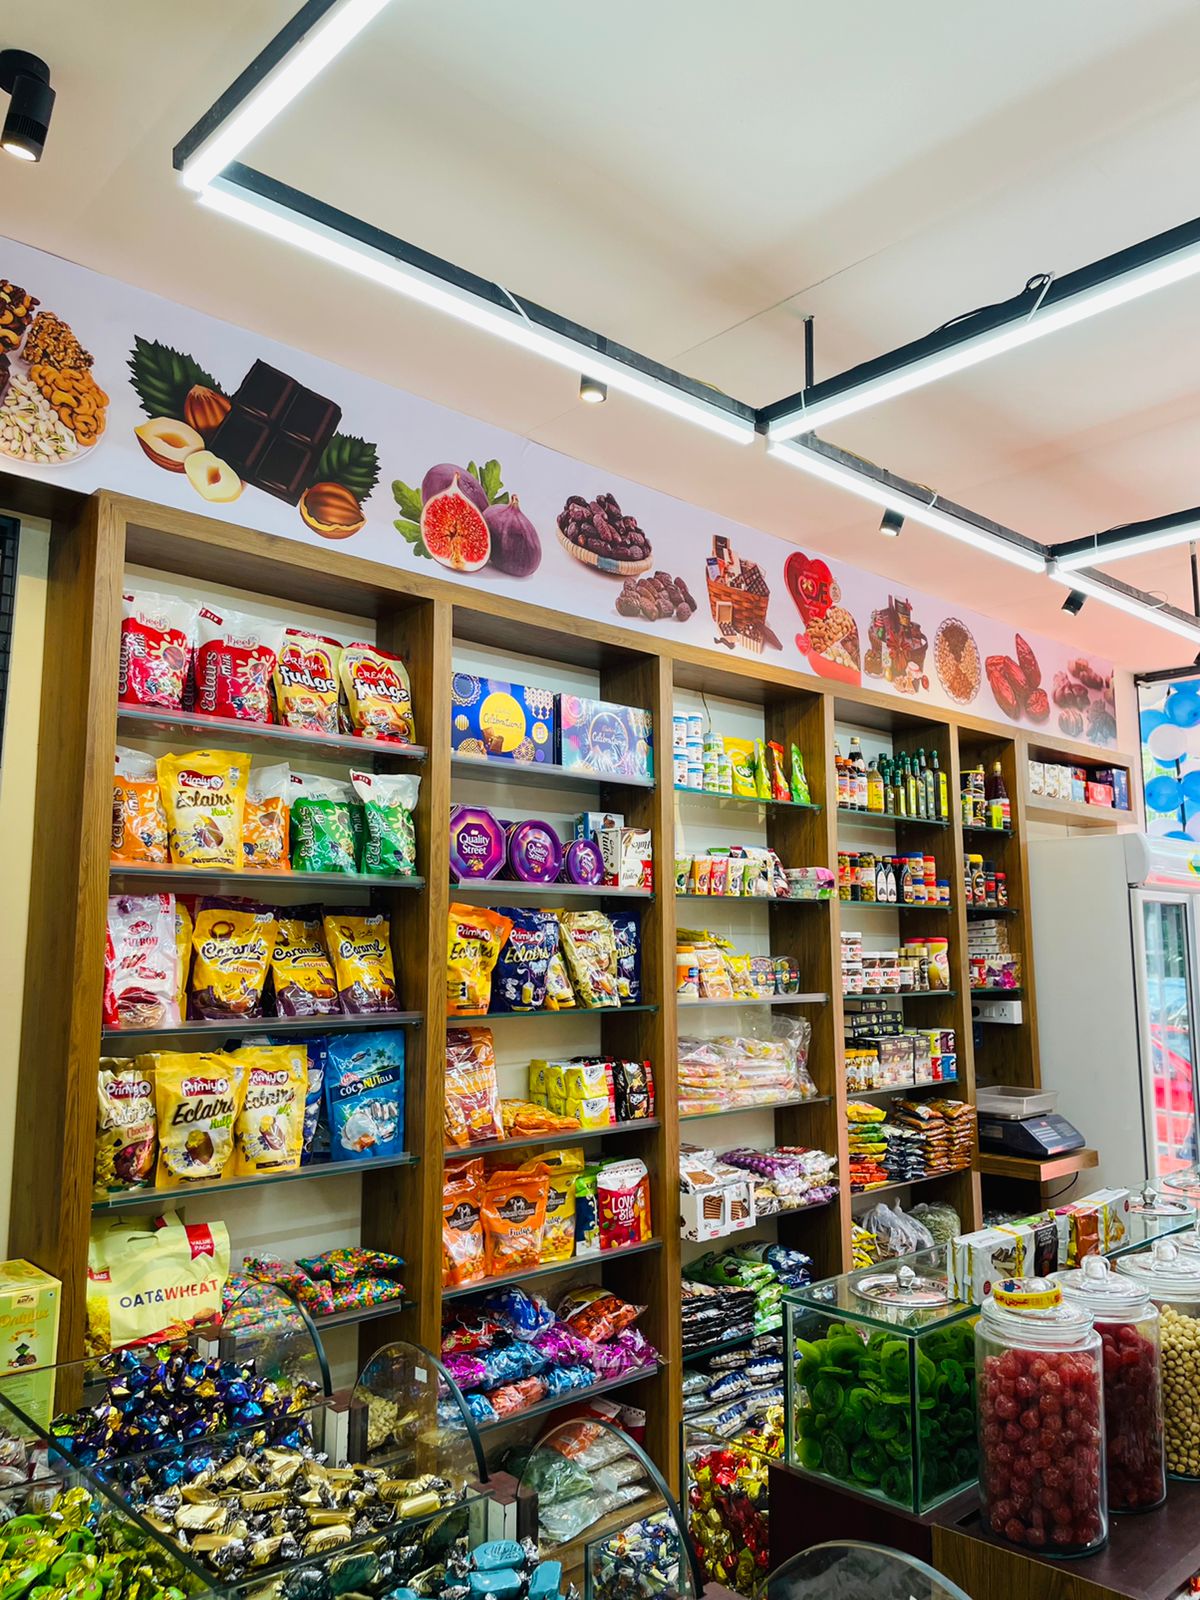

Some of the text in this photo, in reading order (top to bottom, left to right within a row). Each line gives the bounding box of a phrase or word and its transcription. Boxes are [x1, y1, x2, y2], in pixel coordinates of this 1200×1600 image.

[220, 654, 232, 677] Milk
[200, 651, 218, 712] Eclairs
[279, 664, 338, 693] fudge
[354, 678, 411, 704] fudge
[459, 832, 492, 848] Quality
[462, 843, 489, 856] Street
[527, 843, 549, 858] Quality
[528, 852, 547, 864] Street
[201, 937, 267, 961] Caramel
[272, 942, 327, 962] Caramel
[339, 938, 388, 960] Caramel
[504, 945, 550, 965] Eclairs
[303, 961, 330, 969] HONEY
[190, 1238, 212, 1247] VALUE
[193, 1243, 213, 1252] PACK
[119, 1277, 219, 1309] OAT&WHEAT
